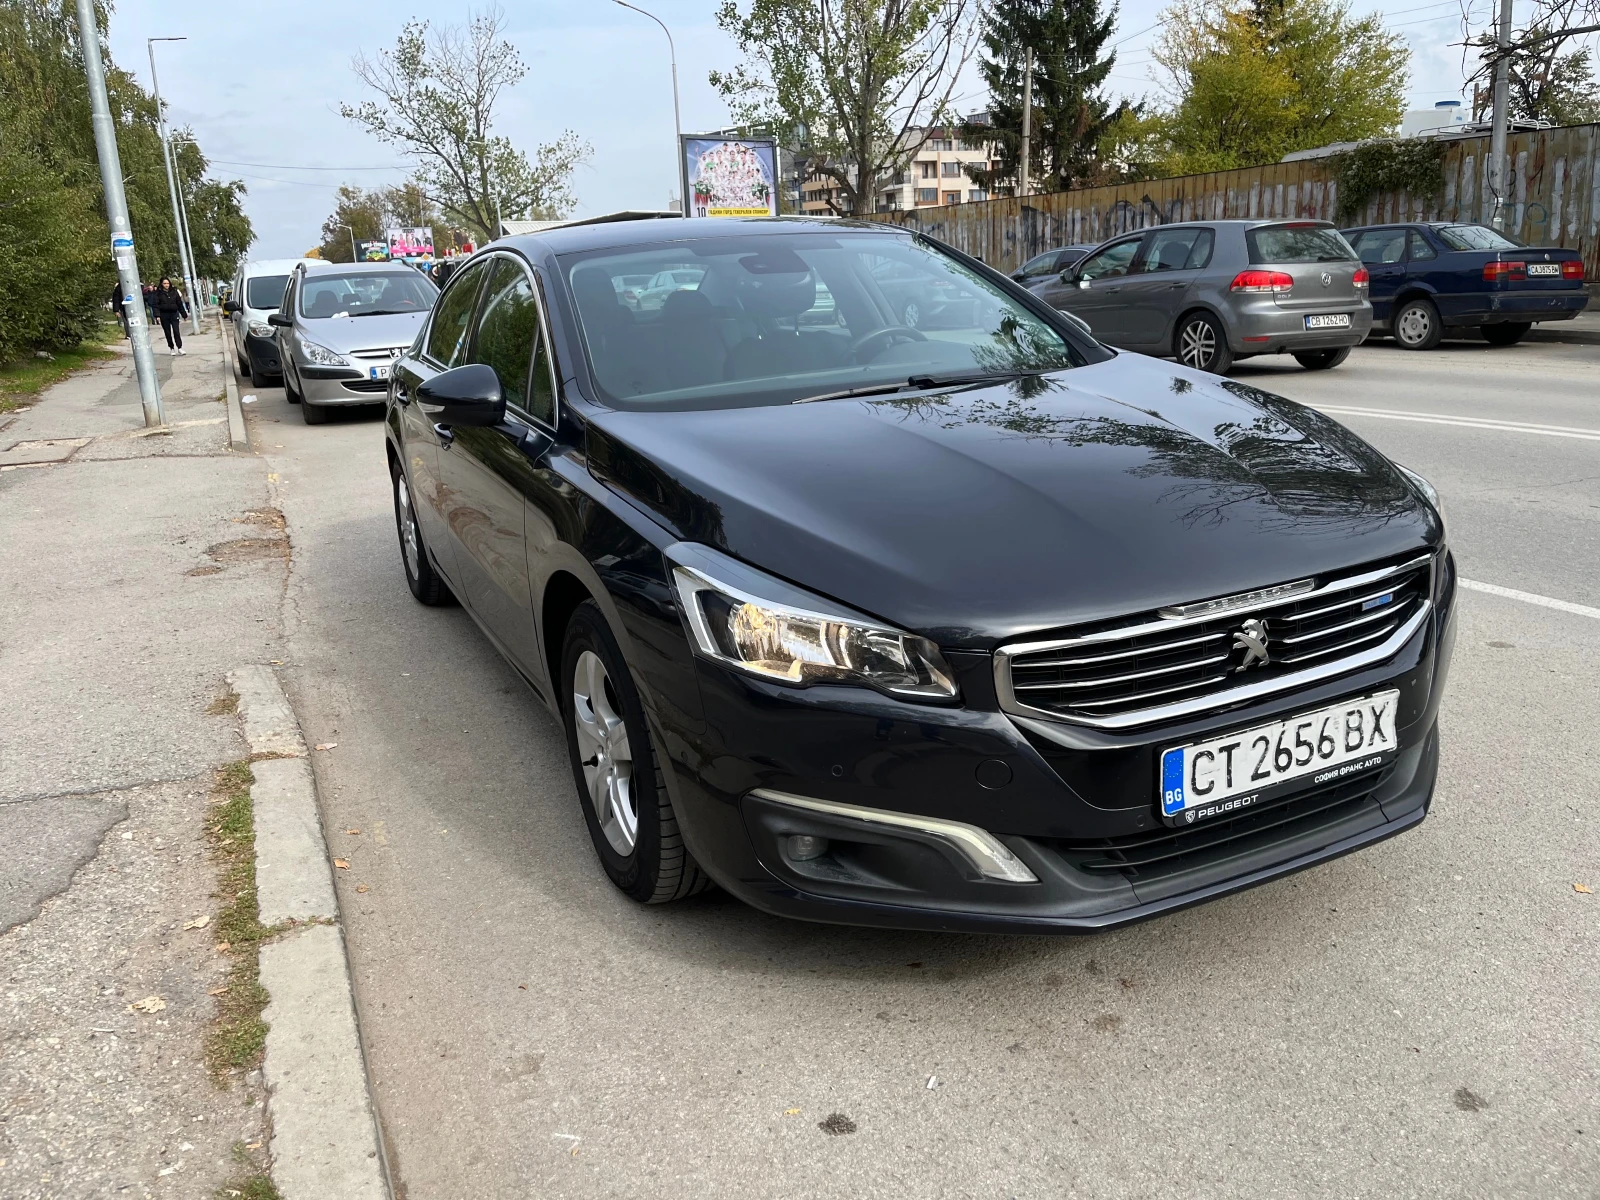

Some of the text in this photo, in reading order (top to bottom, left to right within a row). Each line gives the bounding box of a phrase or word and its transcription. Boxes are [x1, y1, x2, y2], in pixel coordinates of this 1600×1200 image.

[1250, 715, 1336, 782] 2656
[1314, 756, 1382, 784] СОФИЯ ФРАНС АУТО
[1165, 788, 1182, 805] BG
[1198, 794, 1259, 819] PEUGEOT
